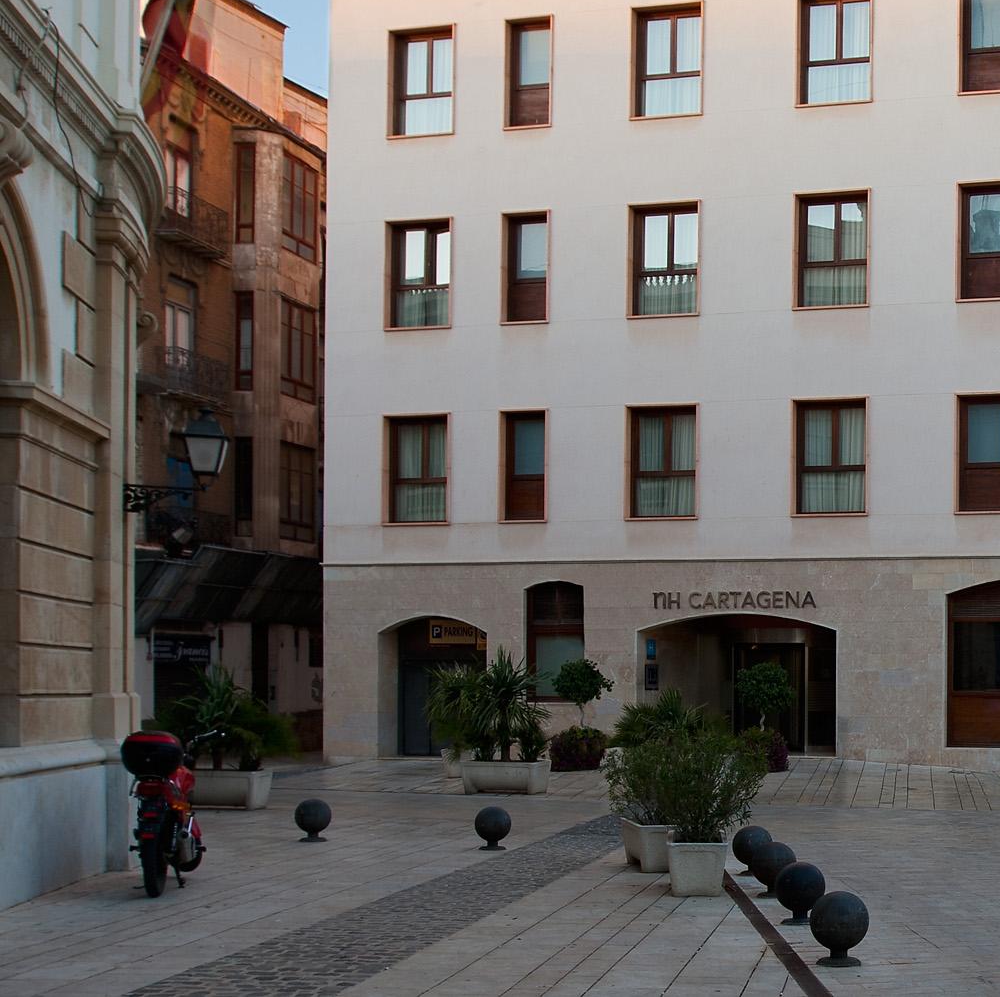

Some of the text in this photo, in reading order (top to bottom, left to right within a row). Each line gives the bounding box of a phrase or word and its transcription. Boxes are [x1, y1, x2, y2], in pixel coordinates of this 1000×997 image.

[688, 591, 816, 609] CARTAGENA
[433, 626, 475, 637] P PARKING
